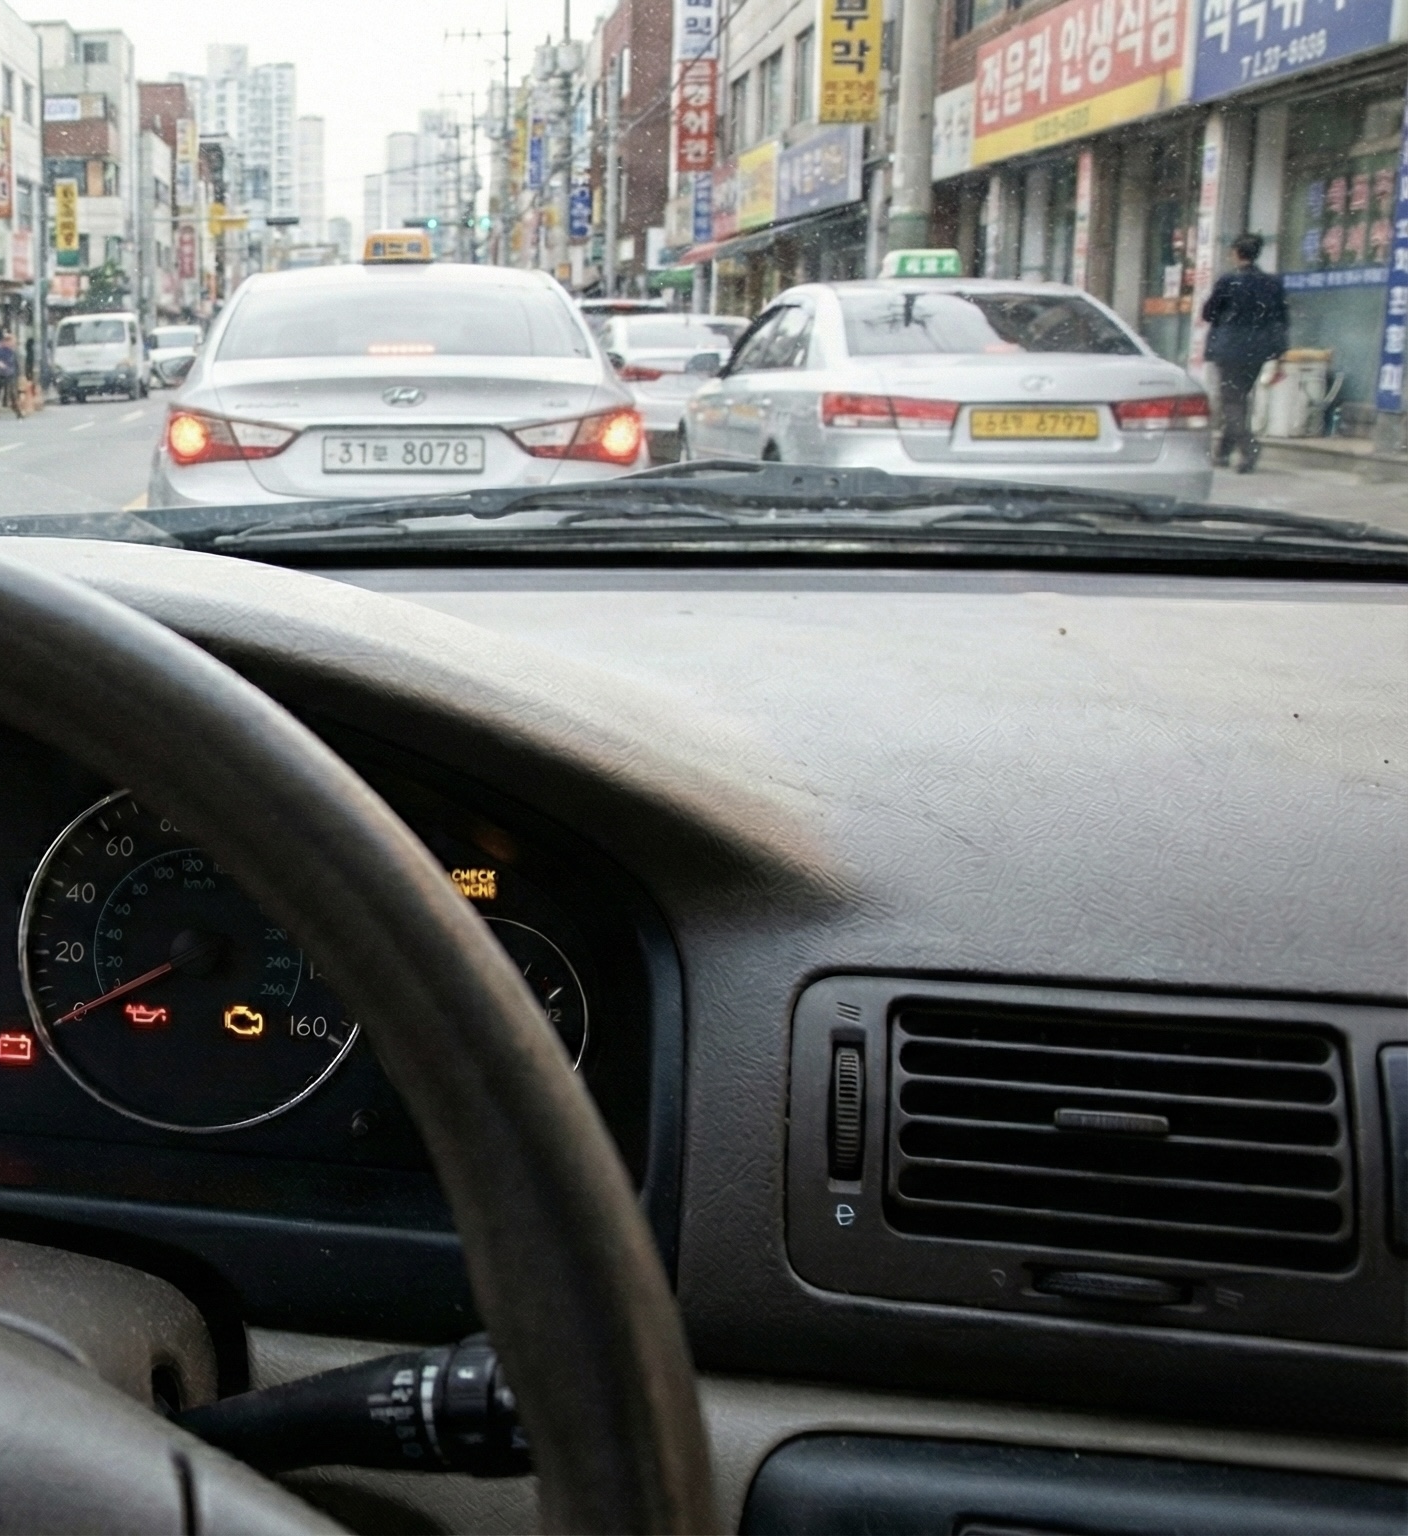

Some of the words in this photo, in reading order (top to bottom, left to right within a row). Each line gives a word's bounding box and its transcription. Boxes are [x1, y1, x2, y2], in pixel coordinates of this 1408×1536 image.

[402, 442, 468, 465] 8078
[106, 836, 134, 857] 60
[451, 868, 496, 882] CHECK
[65, 882, 96, 903] 40
[106, 929, 122, 941] 40
[55, 941, 84, 963] 20
[106, 956, 123, 968] 20
[265, 957, 291, 969] 240
[290, 1015, 327, 1038] 160
